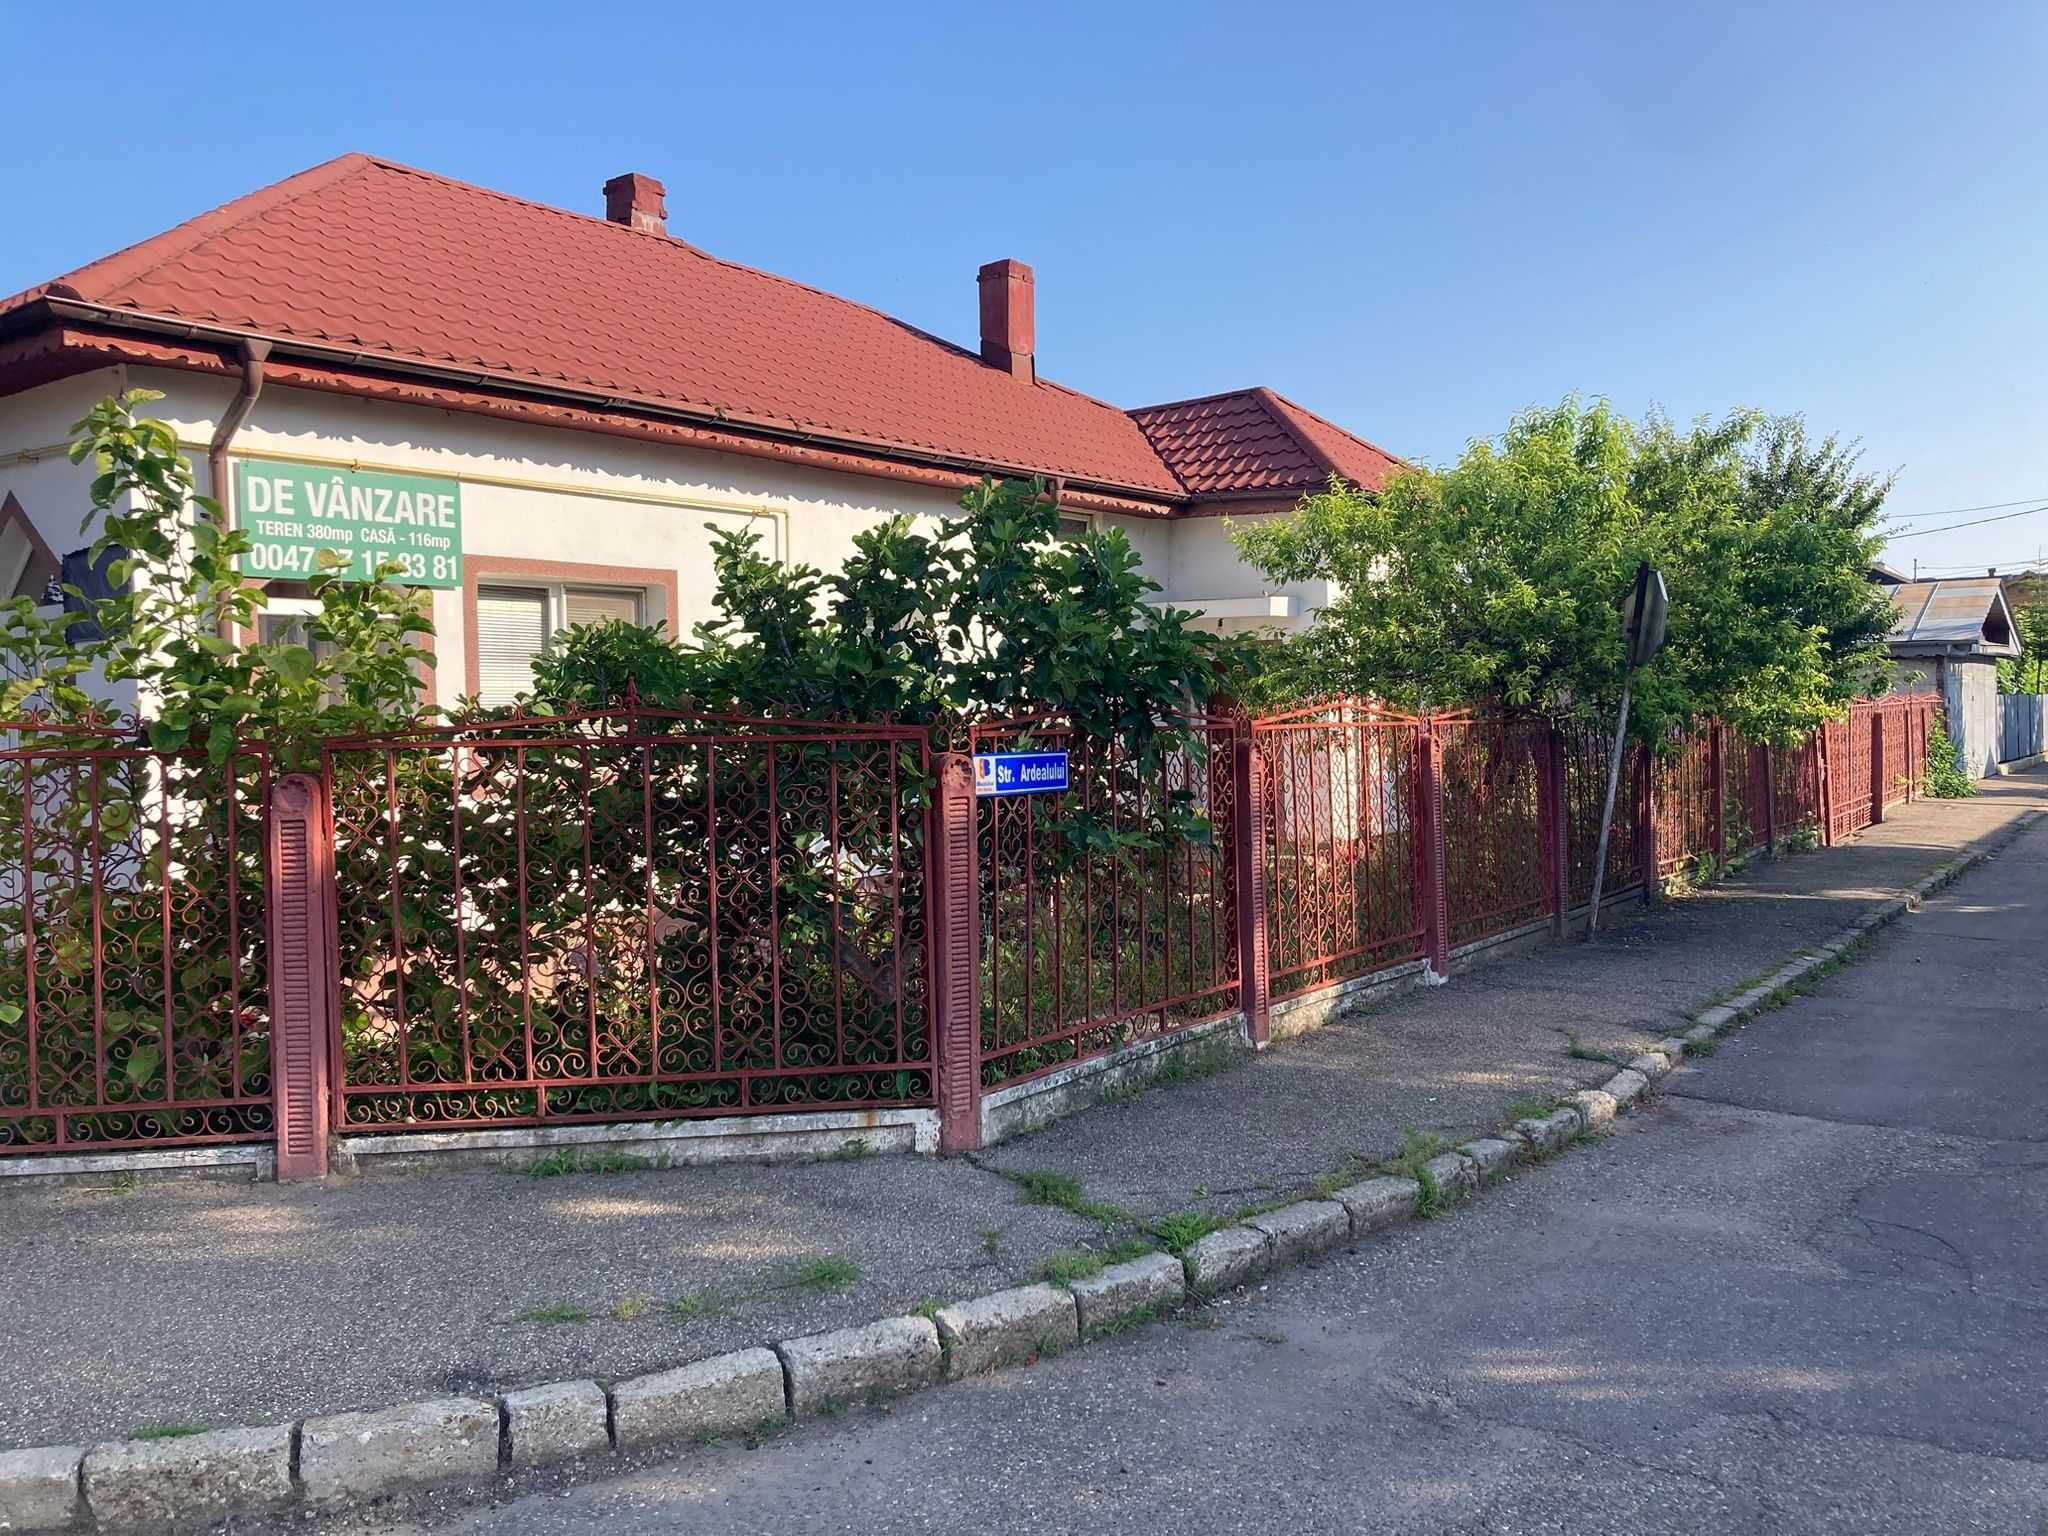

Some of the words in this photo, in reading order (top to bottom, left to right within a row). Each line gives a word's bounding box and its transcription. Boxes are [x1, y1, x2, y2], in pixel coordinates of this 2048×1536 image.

[247, 476, 295, 516] DE
[304, 476, 457, 529] VÂNZARE
[256, 519, 303, 538] TEREN
[306, 524, 353, 544] 380mp
[360, 527, 396, 545] CASĂ
[408, 532, 451, 551] 116mp
[250, 542, 315, 572] 0047
[432, 554, 458, 581] 81
[997, 765, 1015, 784] Str.
[1020, 761, 1065, 782] Ardealului
